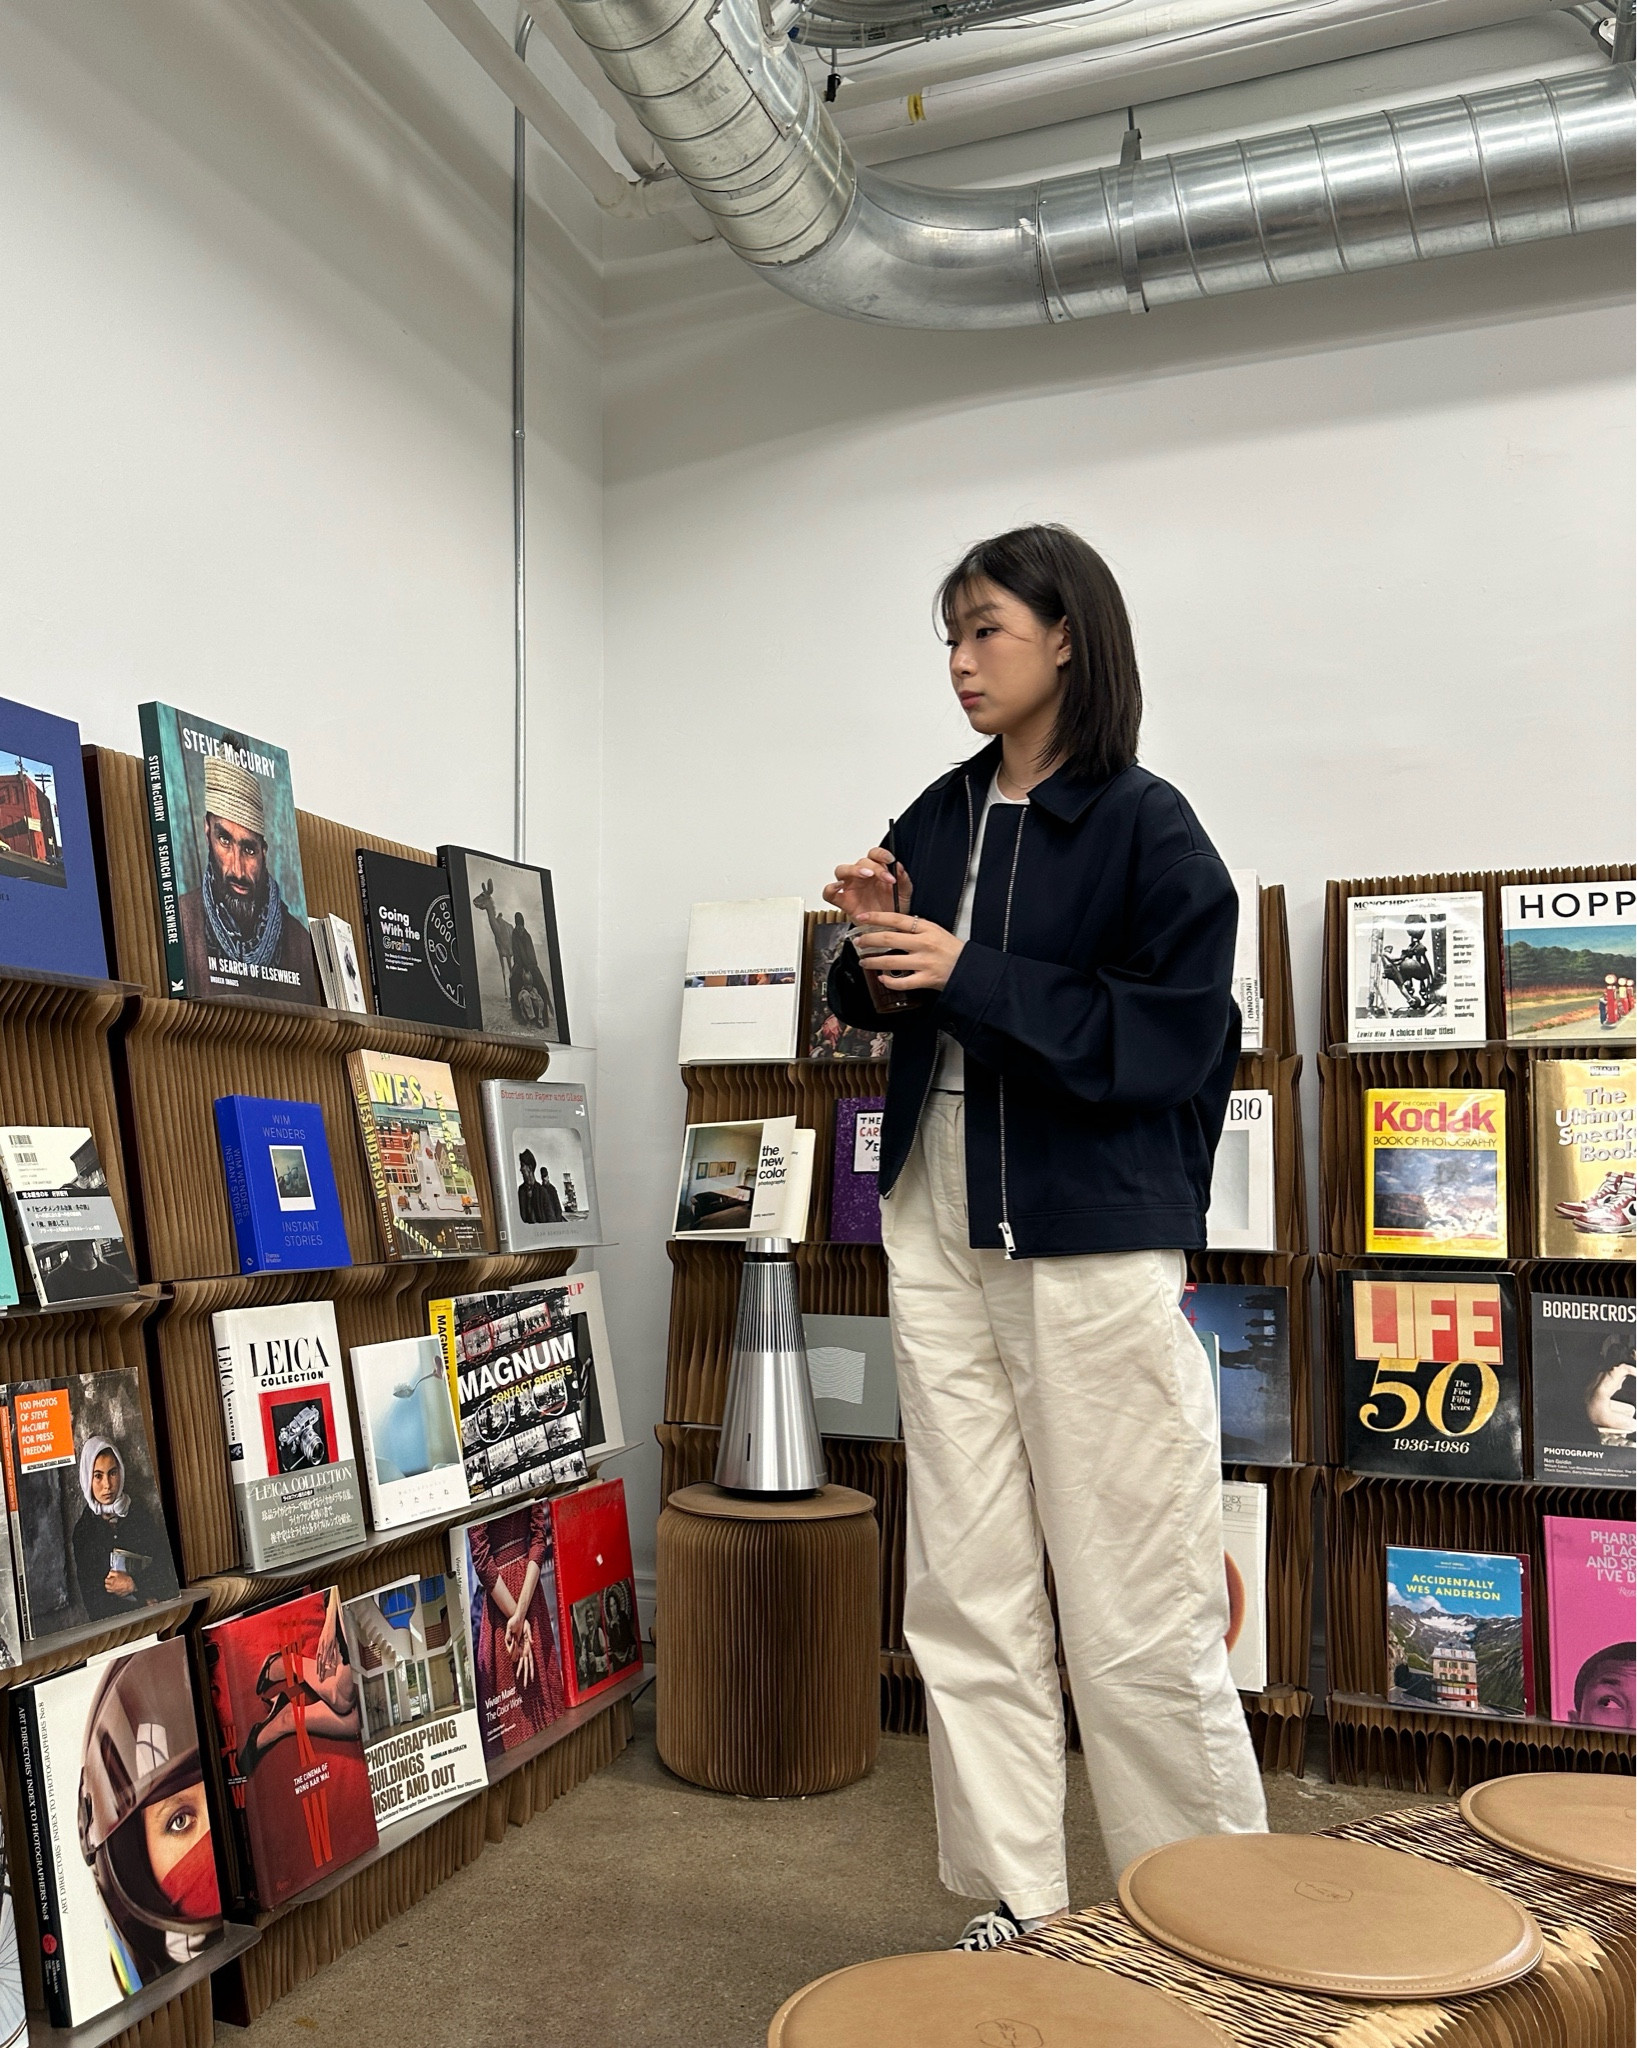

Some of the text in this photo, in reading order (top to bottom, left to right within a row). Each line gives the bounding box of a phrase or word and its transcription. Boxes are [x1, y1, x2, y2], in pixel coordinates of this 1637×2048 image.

[182, 727, 275, 778] STEVE McCURRY
[148, 755, 165, 822] STEVE McCURRY
[157, 833, 178, 944] IN SEARCH OF ELSEWHERE
[440, 901, 454, 929] 500
[1519, 891, 1636, 919] HOPP
[378, 905, 410, 926] Going
[380, 921, 420, 940] With the
[431, 912, 452, 942] 1000
[382, 935, 411, 952] Grain
[428, 939, 436, 953] B
[208, 956, 301, 985] IN SEARCH OF ELSEWHERE
[1245, 982, 1254, 1019] INCONNU
[1389, 1028, 1395, 1037] A
[1396, 1028, 1415, 1037] choice
[370, 1070, 424, 1107] WES
[1583, 1087, 1627, 1105] The
[272, 1114, 290, 1125] WIM
[1374, 1101, 1496, 1133] Kodak
[1555, 1107, 1636, 1128] Ultima
[262, 1127, 306, 1140] WENDERS
[434, 1090, 459, 1174] ANDERSON
[1373, 1136, 1497, 1148] BOOK OF PHOTOGRAPHY
[1558, 1122, 1636, 1146] Sneak
[357, 1090, 387, 1200] WES ANDERSON
[762, 1145, 779, 1156] the
[760, 1157, 784, 1167] new
[233, 1148, 250, 1217] WIM WENDERS
[759, 1168, 787, 1179] color
[225, 1145, 243, 1225] INSTANT STORIES
[282, 1220, 320, 1232] INSTANT
[381, 1202, 393, 1243] COLLECTION
[284, 1234, 323, 1247] STORIES
[1353, 1281, 1502, 1364] LIFE
[248, 1336, 330, 1378] LEICA
[458, 1332, 576, 1405] MAGNUM
[260, 1371, 324, 1387] COLLECTION
[491, 1365, 573, 1404] CONTACT SHEETS
[1454, 1379, 1470, 1388] The
[217, 1346, 236, 1441] LEICA COLLECTION
[1358, 1354, 1500, 1437] 50
[1451, 1395, 1470, 1405] Fifty
[1453, 1387, 1472, 1395] First
[20, 1397, 58, 1410] 100 PHOTOS
[1450, 1402, 1471, 1411] Years
[20, 1410, 48, 1422] OF STEVE
[21, 1421, 50, 1433] McCURRY
[22, 1432, 55, 1445] FOR PRESS
[1392, 1438, 1471, 1454] 1936-1986
[23, 1444, 53, 1456] FREEDOM
[1543, 1447, 1604, 1459] PHOTOGRAPHY
[254, 1481, 291, 1501] LEICA
[291, 1466, 353, 1492] COLLECTION
[1591, 1531, 1636, 1545] PHARR
[1603, 1544, 1636, 1558] PLAC
[1586, 1556, 1636, 1570] AND SP
[1411, 1574, 1494, 1589] ACCIDENTALLY
[1597, 1569, 1623, 1583] I'VE
[1406, 1584, 1501, 1600] WES ANDERSON
[484, 1686, 516, 1709] Vivian Maier
[18, 1707, 26, 1725] ART
[485, 1696, 523, 1722] The Color Work
[20, 1726, 32, 1777] DIRECTORS'
[365, 1719, 458, 1772] PHOTOGRAPHING
[41, 1721, 54, 1797] PHOTOGRAPHERS
[293, 1762, 328, 1785] THE CINEMA OF
[368, 1752, 425, 1794] BUILDINGS
[26, 1779, 36, 1807] INDEX
[294, 1783, 309, 1795] WONG
[309, 1776, 320, 1787] KAR
[373, 1763, 456, 1815] NSIDE AND OUT
[49, 1798, 56, 1812] TO
[30, 1809, 38, 1822] TO
[50, 1814, 60, 1842] INDEX
[31, 1823, 47, 1905] PHOTOGRAPHERS
[60, 1897, 68, 1914] ART
